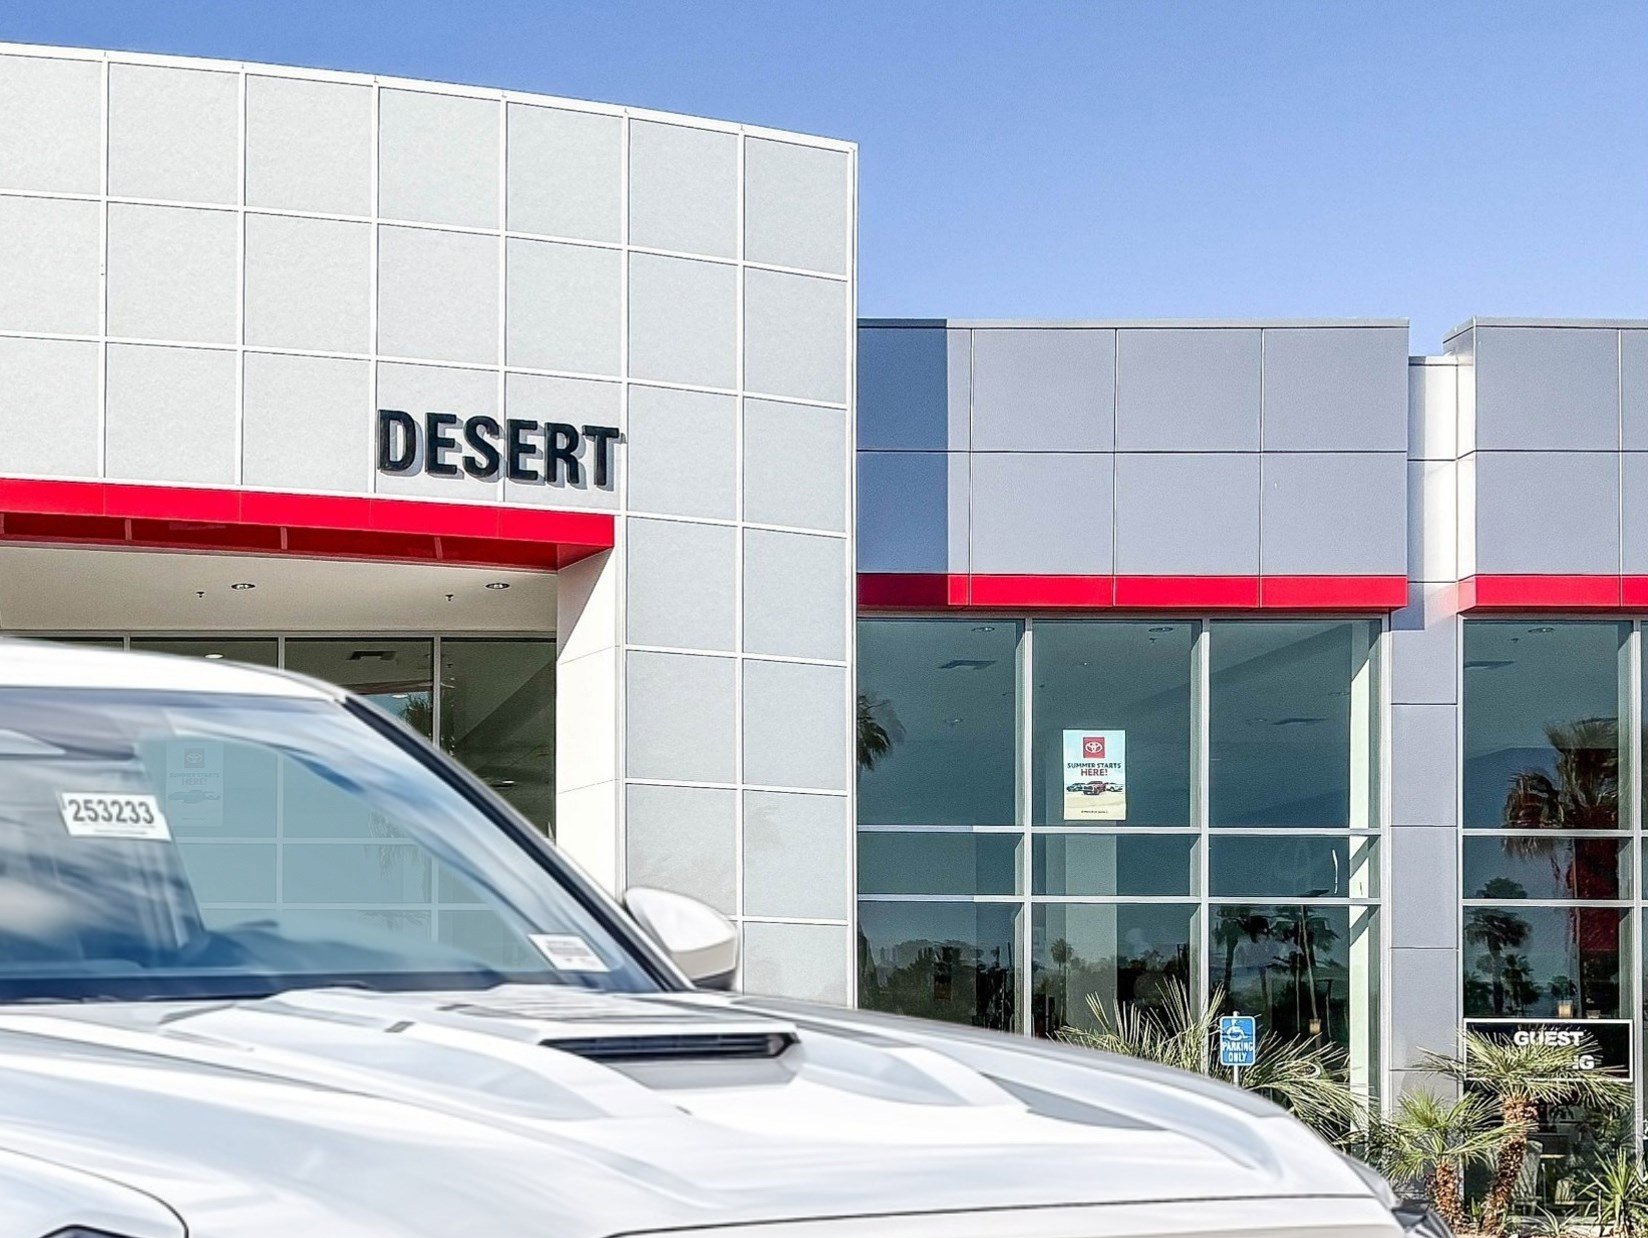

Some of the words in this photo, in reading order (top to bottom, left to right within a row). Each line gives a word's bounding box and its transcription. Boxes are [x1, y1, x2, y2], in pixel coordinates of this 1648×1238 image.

[377, 409, 620, 486] DESERT
[68, 799, 155, 824] 253233
[1222, 1041, 1253, 1051] PARKING
[1513, 1031, 1584, 1046] GUEST
[1228, 1052, 1247, 1062] ONLY
